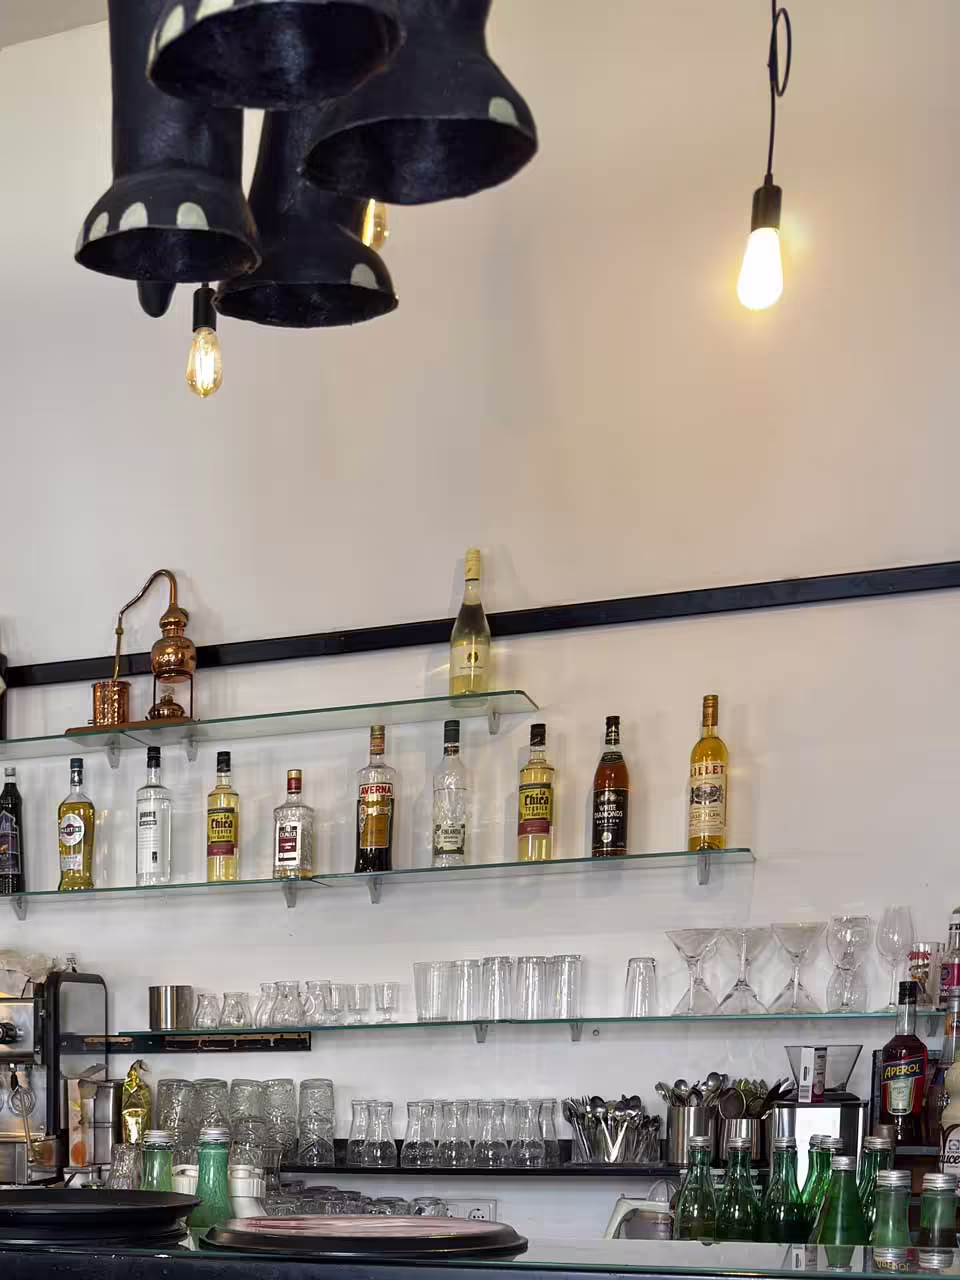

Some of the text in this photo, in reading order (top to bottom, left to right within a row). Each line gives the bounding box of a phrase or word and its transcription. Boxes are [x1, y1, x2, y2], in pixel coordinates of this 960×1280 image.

[361, 785, 391, 795] AVERNA
[524, 793, 548, 806] Chica
[211, 818, 233, 829] Chica
[884, 1063, 921, 1079] APEROL
